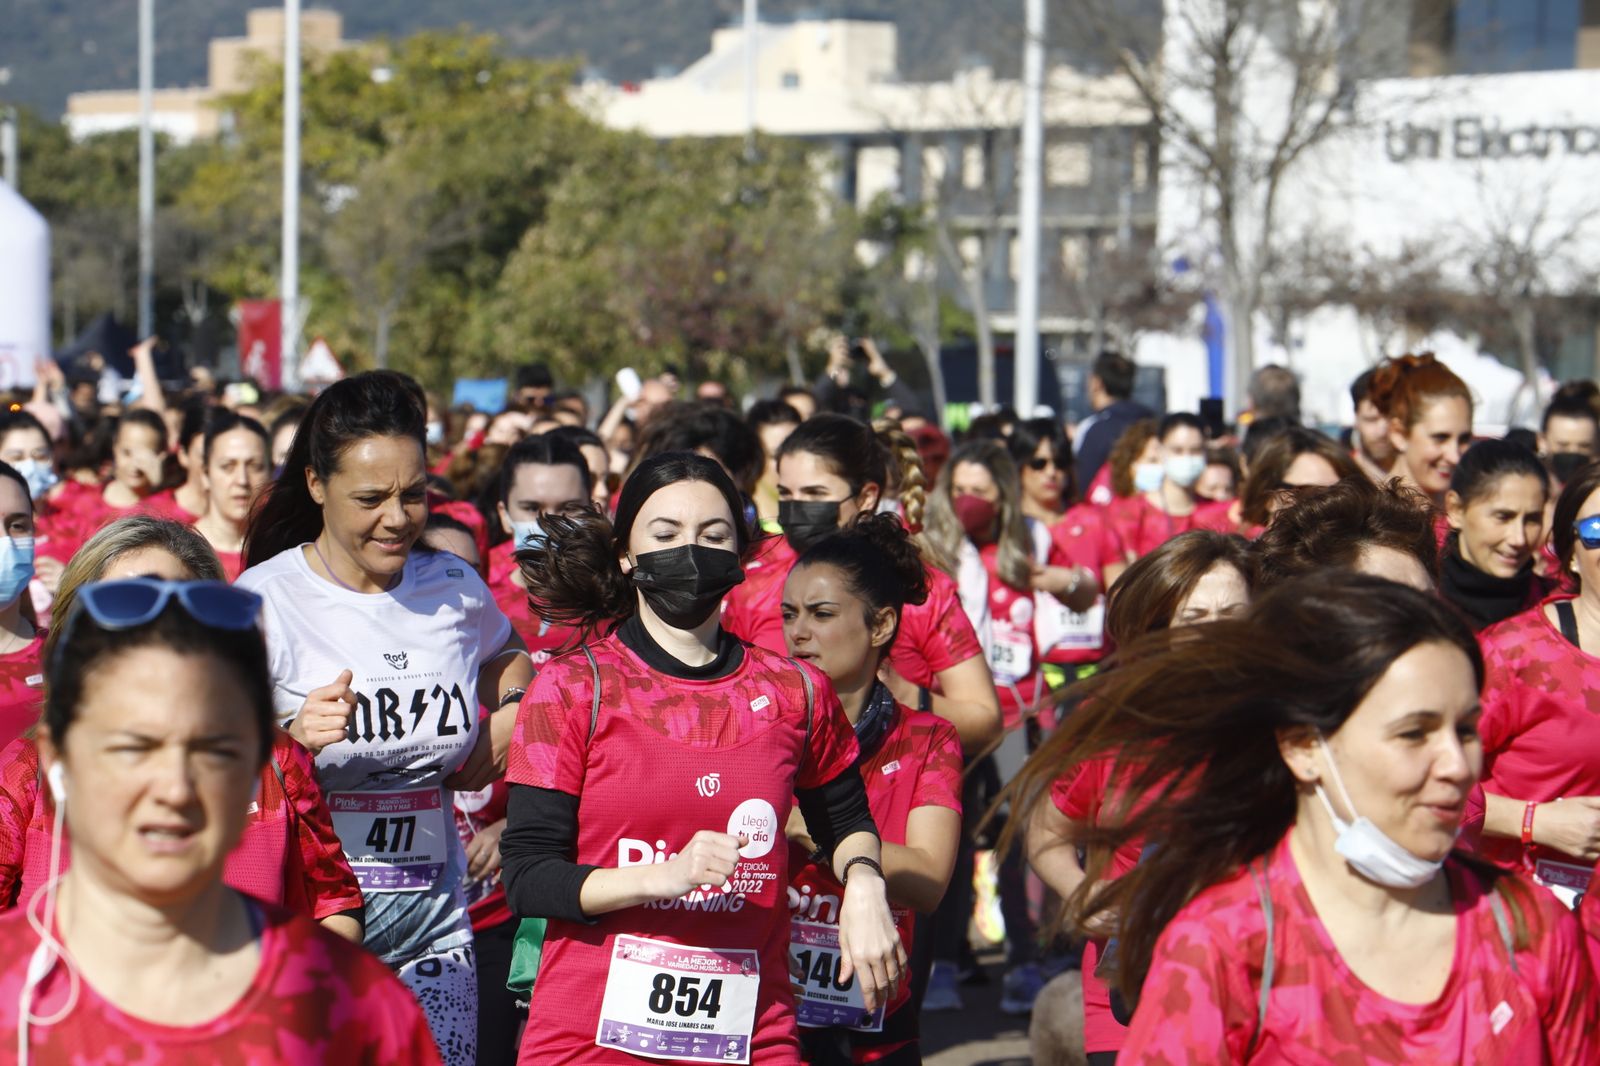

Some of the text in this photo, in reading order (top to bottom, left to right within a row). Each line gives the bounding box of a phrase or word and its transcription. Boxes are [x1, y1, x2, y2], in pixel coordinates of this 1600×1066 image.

[742, 814, 768, 829] Llegó
[365, 815, 416, 853] 477
[752, 830, 768, 842] día
[743, 862, 769, 871] EDICIÓN
[734, 870, 777, 880] 6 de marzo
[731, 880, 763, 893] 2022
[667, 960, 725, 972] VARIEDAD MUSICAL
[678, 955, 690, 964] LA
[690, 957, 717, 966] MEJOR
[648, 972, 723, 1019] 854
[646, 1017, 665, 1026] MARIA
[665, 1020, 678, 1028] JOSE
[678, 1021, 700, 1030] LINARES
